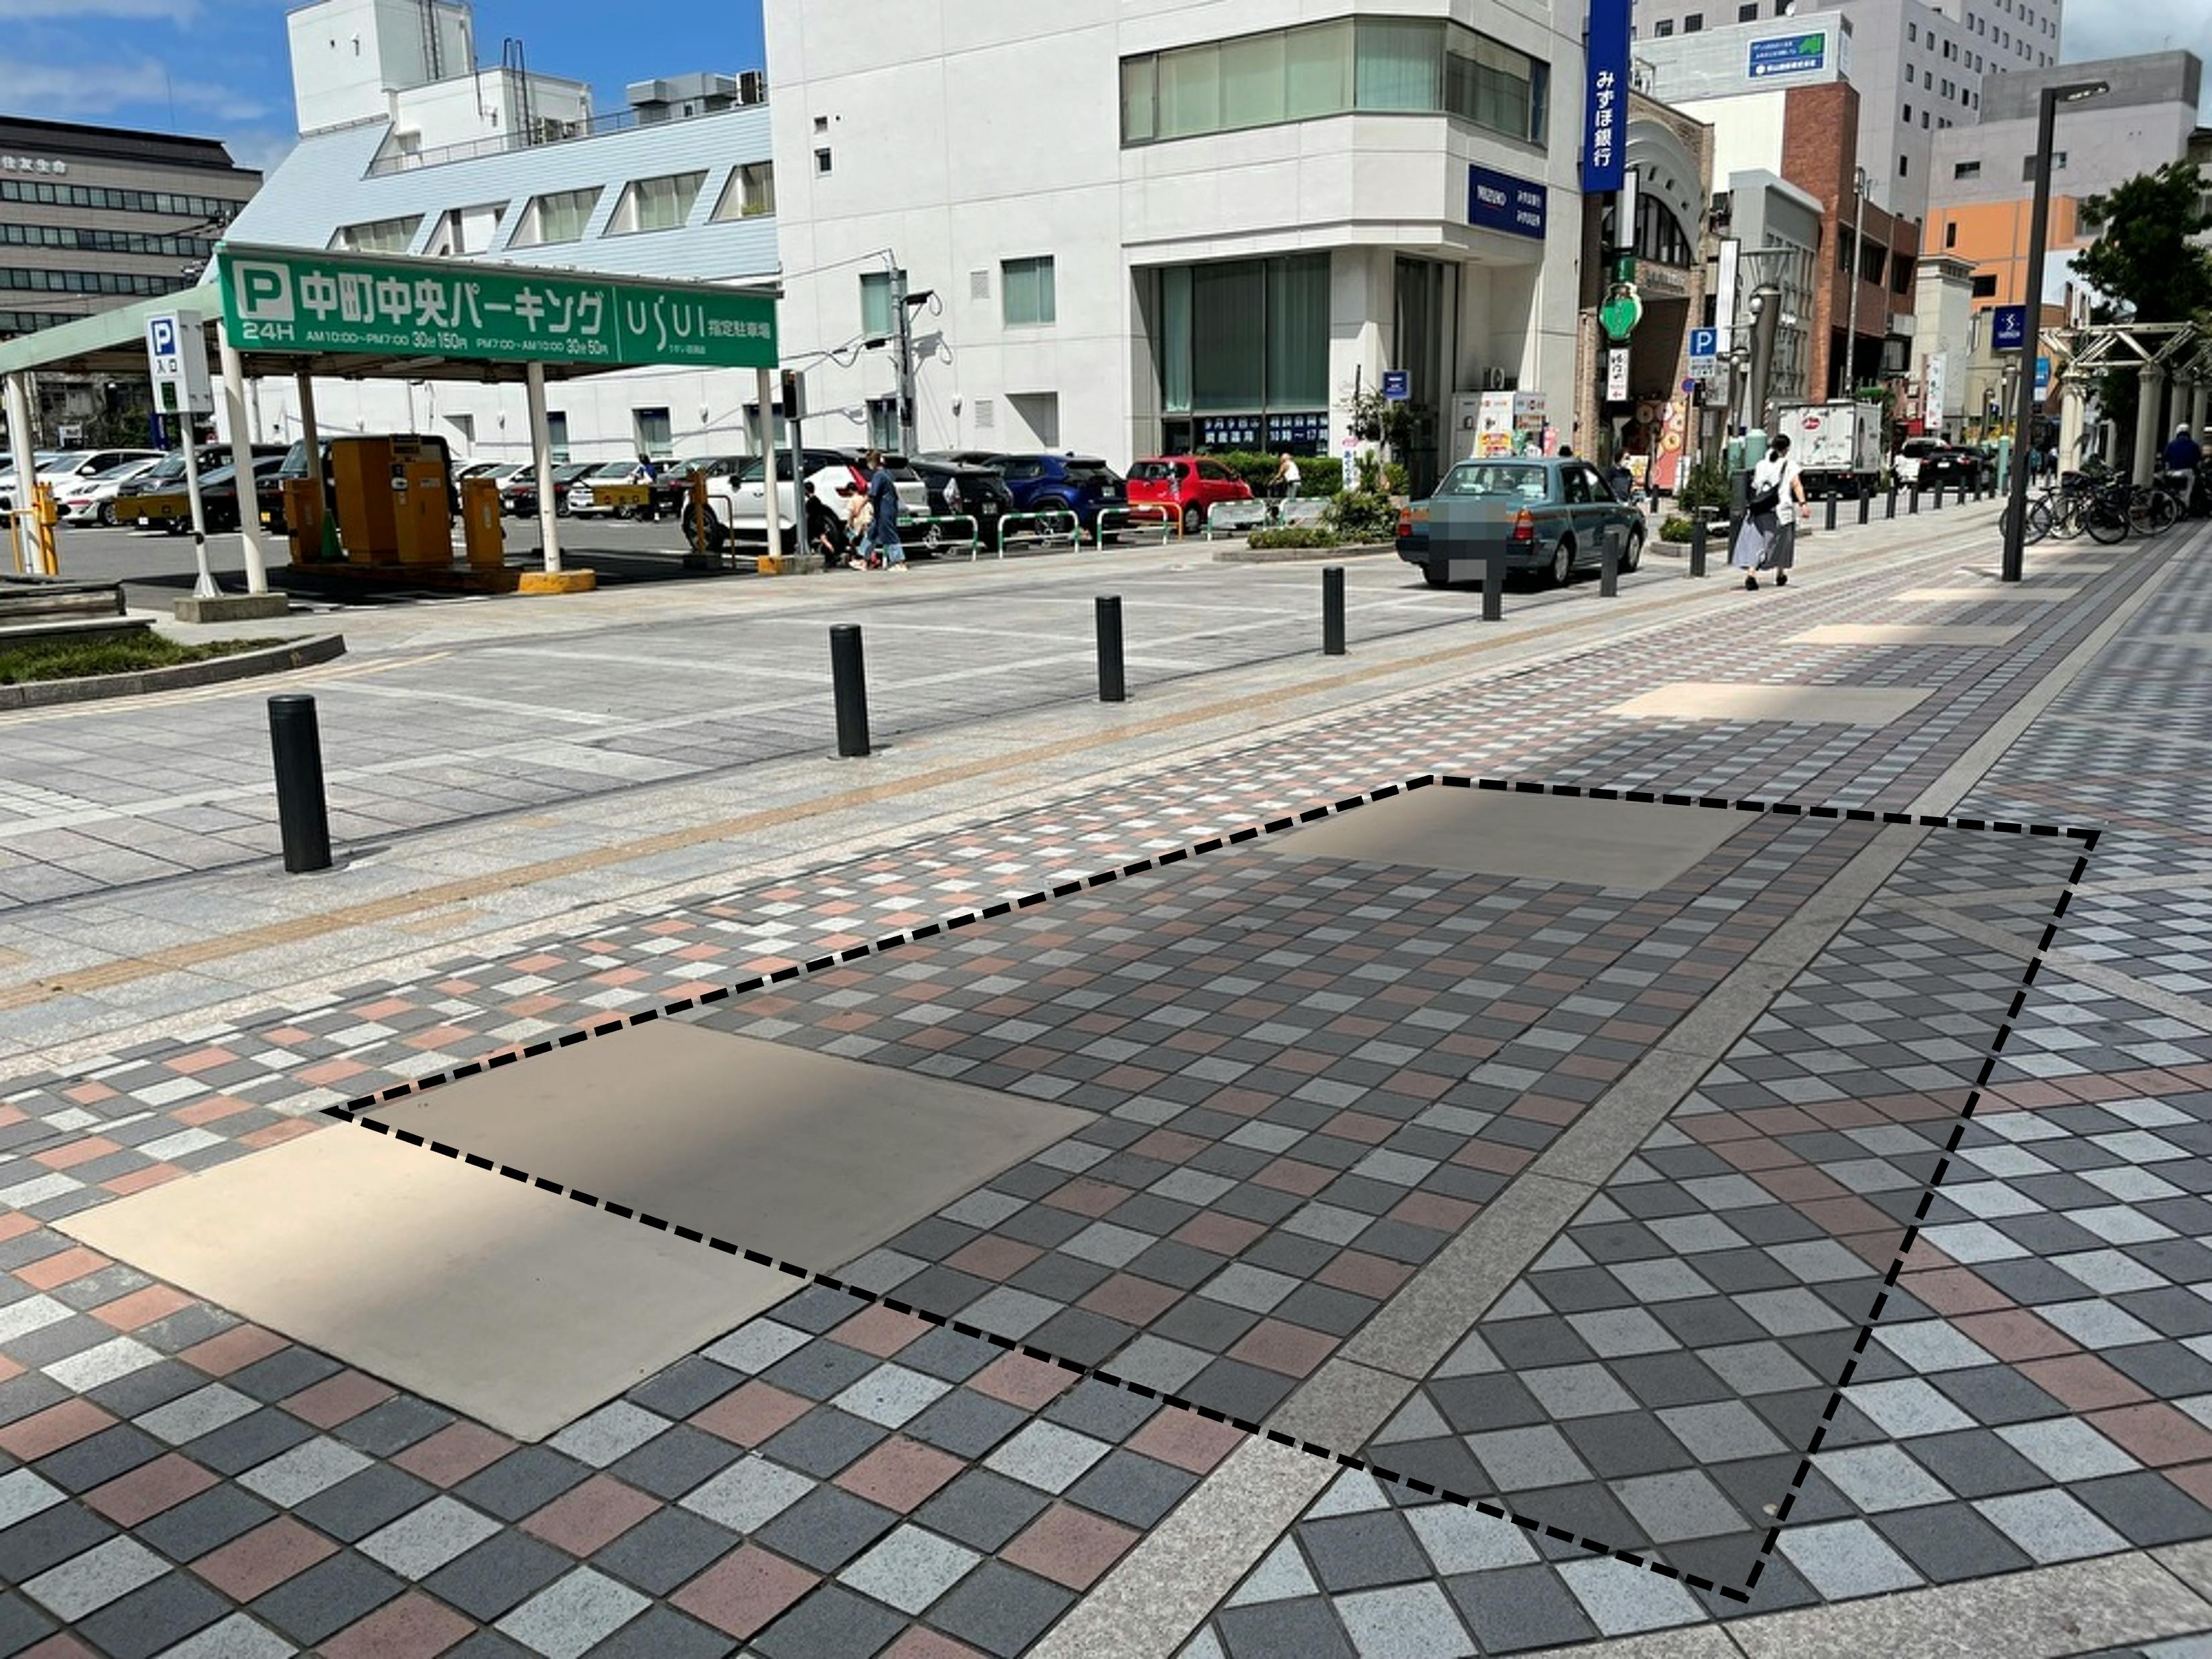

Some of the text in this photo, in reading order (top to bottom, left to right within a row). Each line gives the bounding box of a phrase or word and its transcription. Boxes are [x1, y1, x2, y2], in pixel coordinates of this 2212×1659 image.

[1593, 70, 1615, 167] みずほ銀行
[1, 156, 66, 174] 住友生命
[242, 269, 283, 314] P
[299, 270, 604, 334] 中町中央パーキング
[154, 322, 172, 353] P
[242, 322, 295, 341] 24H
[708, 320, 770, 339] 指定駐車場
[1697, 332, 1713, 354] P
[157, 359, 178, 374] 入口
